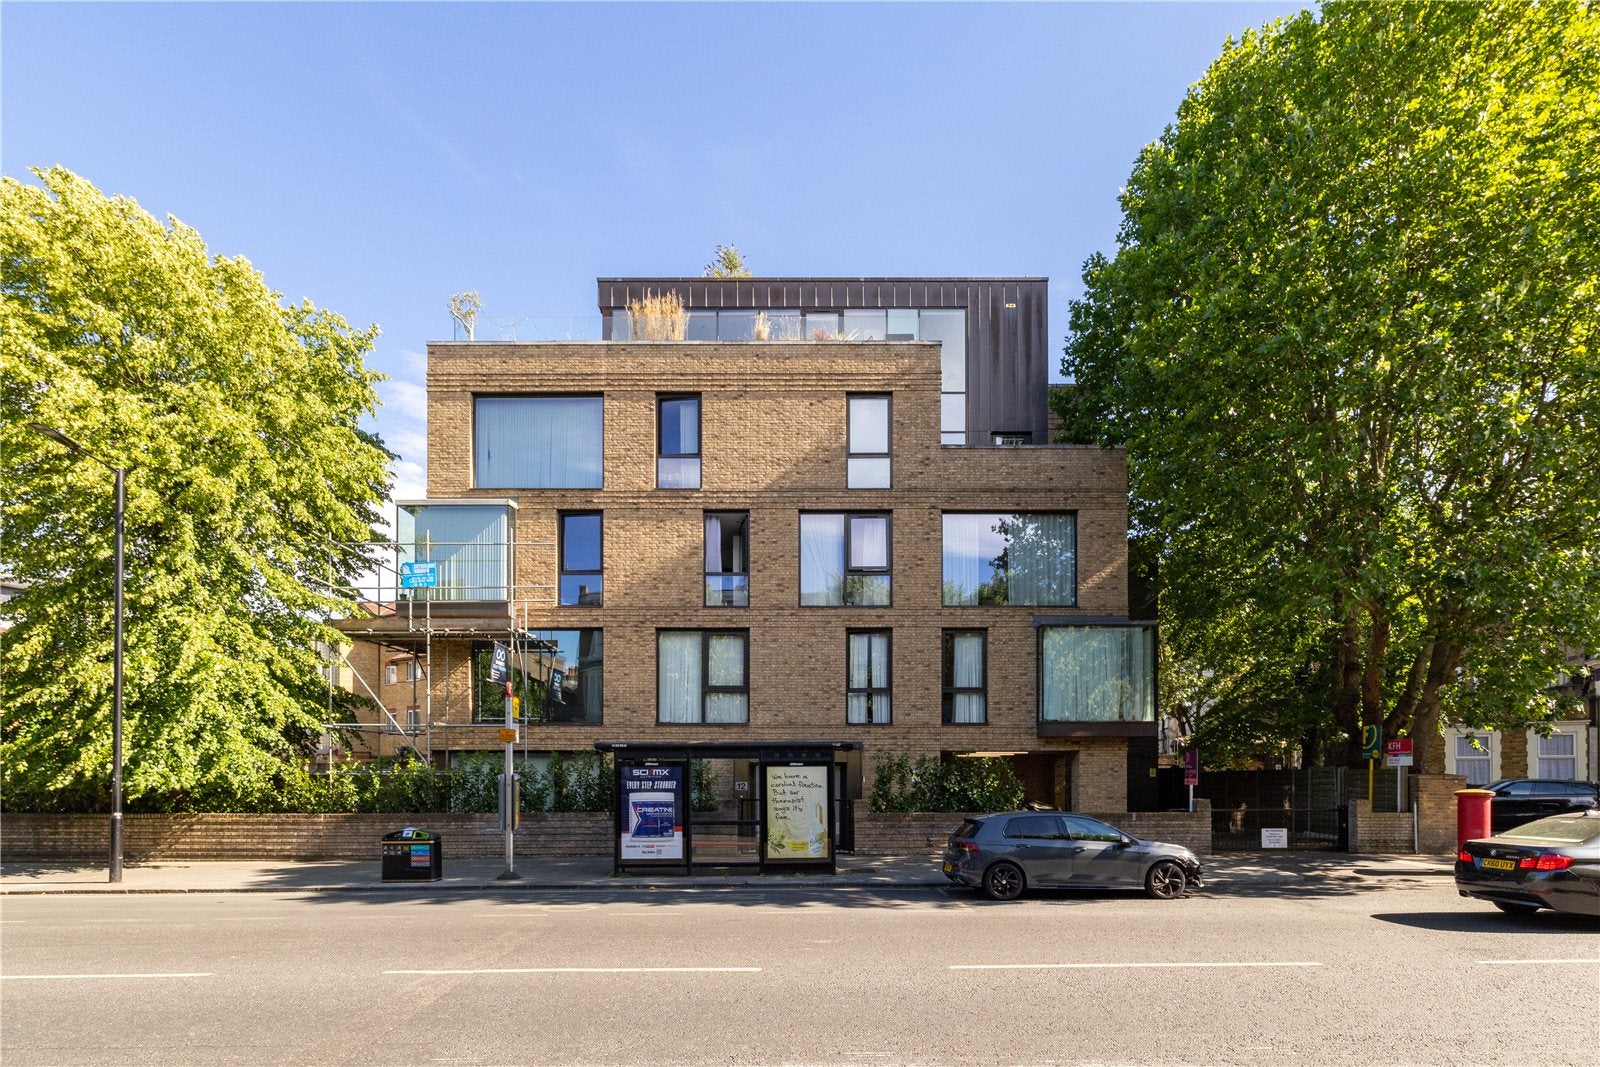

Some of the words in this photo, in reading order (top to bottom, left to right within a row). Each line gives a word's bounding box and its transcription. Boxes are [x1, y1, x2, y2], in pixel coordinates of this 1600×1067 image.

[1388, 741, 1401, 750] KFH
[626, 781, 640, 789] EVERY
[641, 781, 653, 789] STEP
[655, 781, 677, 789] STRONGER
[772, 788, 788, 796] But
[1483, 859, 1499, 867] CK60
[1500, 861, 1514, 869] UYX
